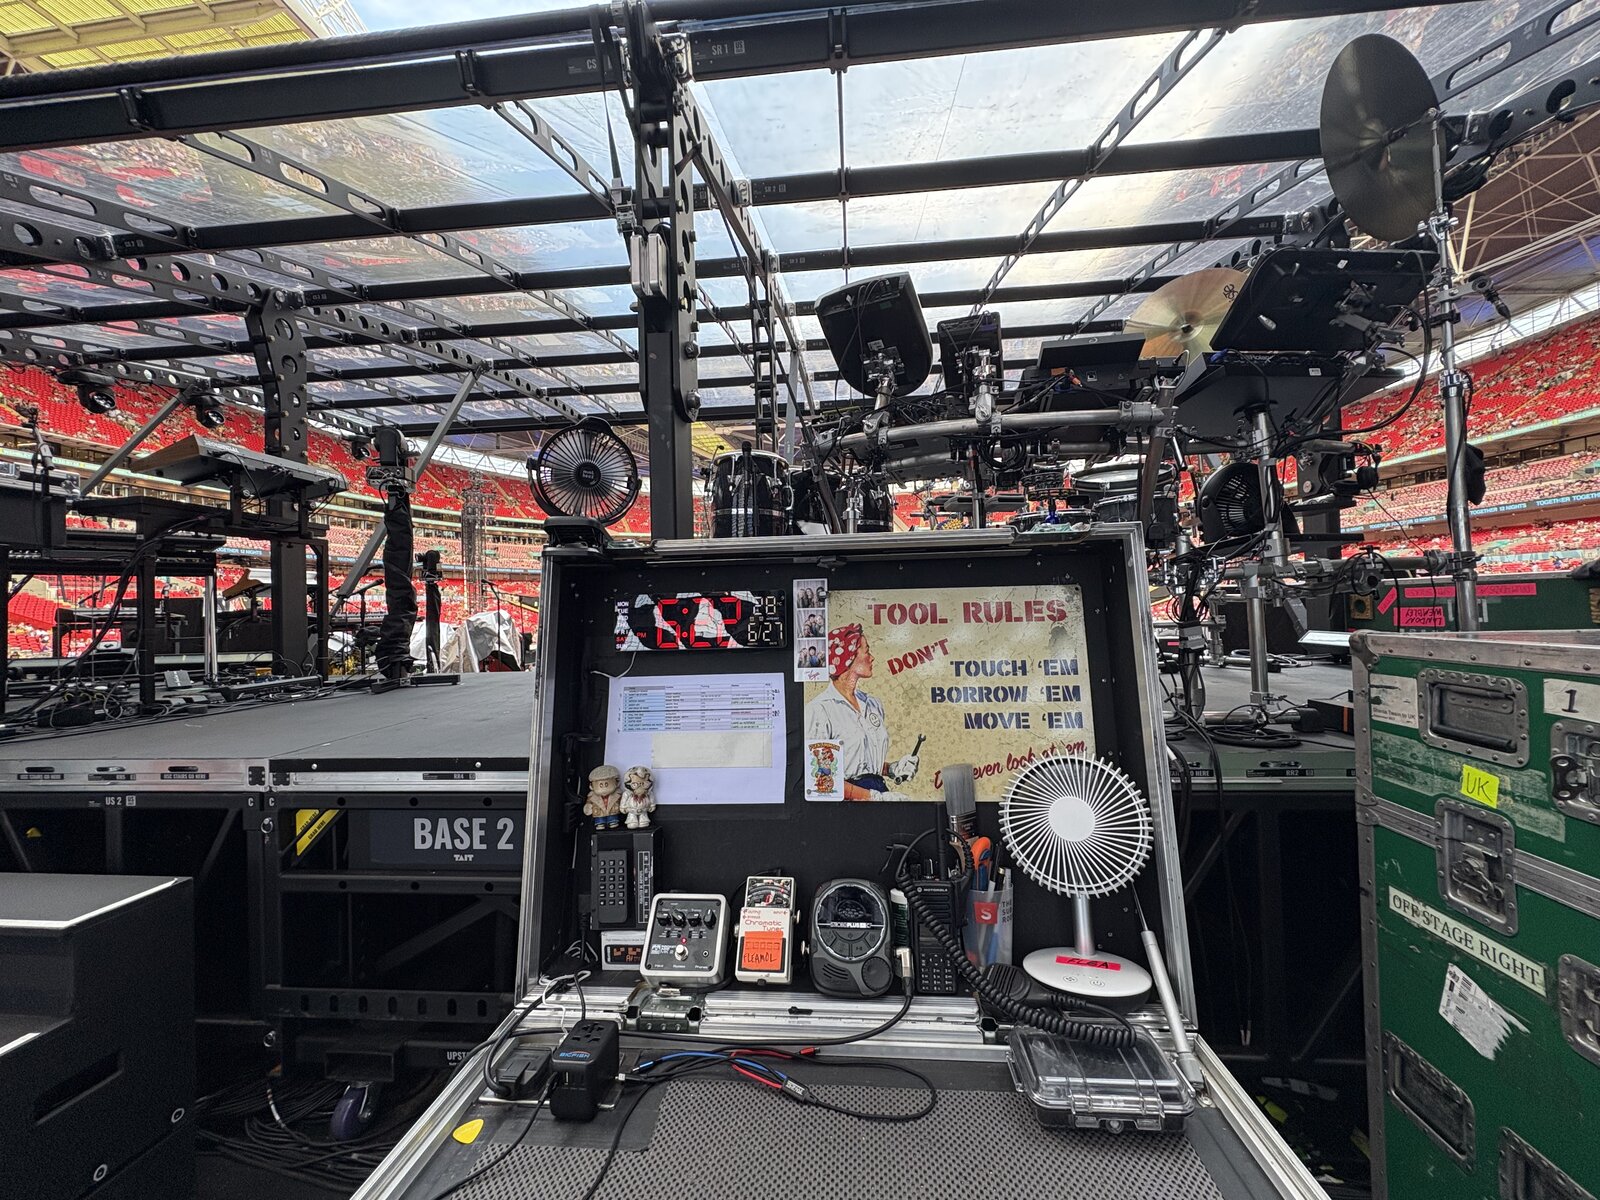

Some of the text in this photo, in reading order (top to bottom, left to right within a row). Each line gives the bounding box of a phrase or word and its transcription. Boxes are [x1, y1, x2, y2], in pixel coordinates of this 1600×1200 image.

[711, 45, 723, 56] SR
[1470, 507, 1498, 516] TOGETHER
[1505, 502, 1527, 511] NIGHTS
[1536, 496, 1570, 506] TOGETHER
[868, 600, 1068, 625] TOOL RULES
[747, 621, 783, 642] 6/27
[886, 638, 949, 676] DON'T
[950, 658, 1079, 677] TOUCH 'EM
[930, 685, 1081, 703] BORROW 'EM
[1561, 688, 1578, 713] 1
[963, 711, 1084, 729] MOVE 'EM
[973, 761, 1004, 780] even
[1006, 747, 1037, 772] look
[1466, 772, 1493, 803] UK
[105, 796, 122, 805] US 2
[248, 798, 254, 806] C
[269, 798, 275, 806] C
[413, 817, 515, 850] BASE 2
[1422, 910, 1475, 951] STAGE
[1479, 940, 1540, 985] RIGHT
[1067, 958, 1109, 969] FLEA
